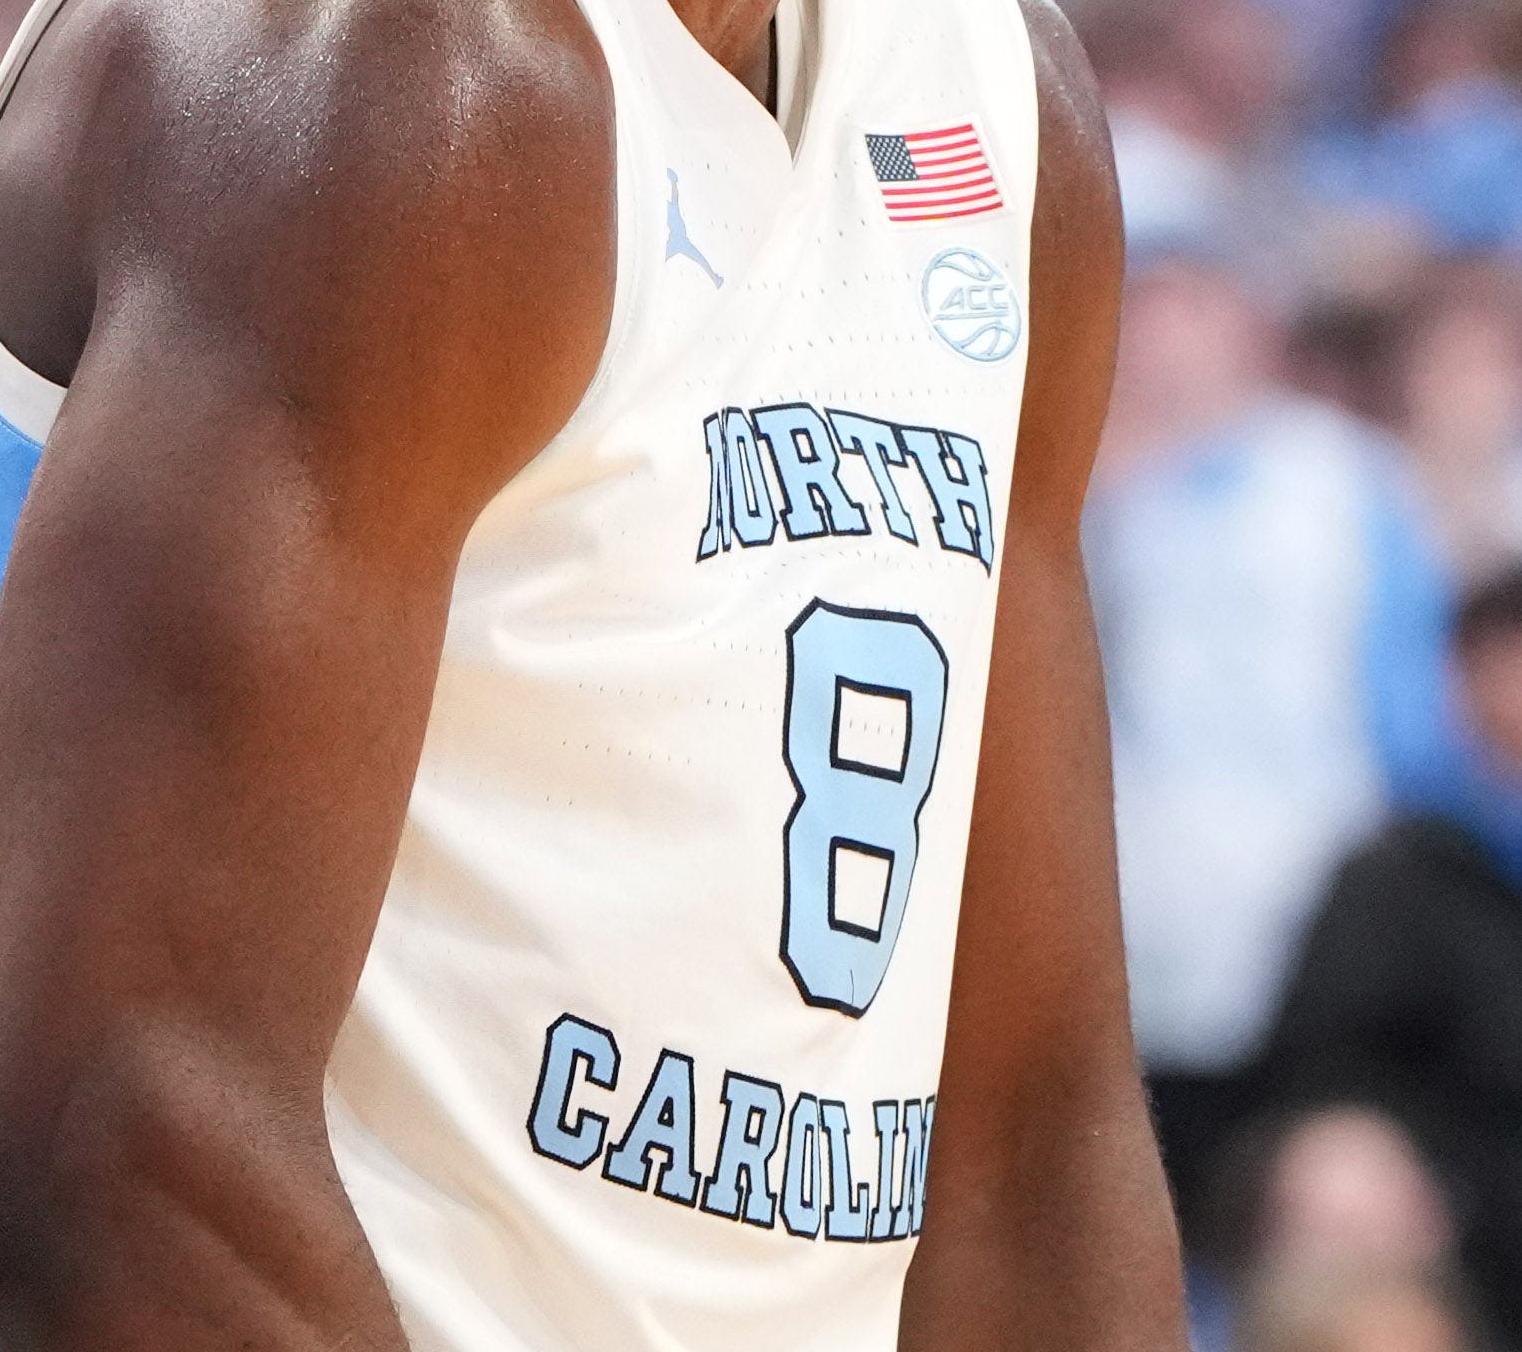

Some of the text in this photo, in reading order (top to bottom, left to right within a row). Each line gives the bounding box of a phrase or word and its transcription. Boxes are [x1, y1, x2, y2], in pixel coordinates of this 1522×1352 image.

[939, 284, 1009, 311] ACC
[696, 402, 994, 578] NORTH
[779, 596, 949, 1019] 8
